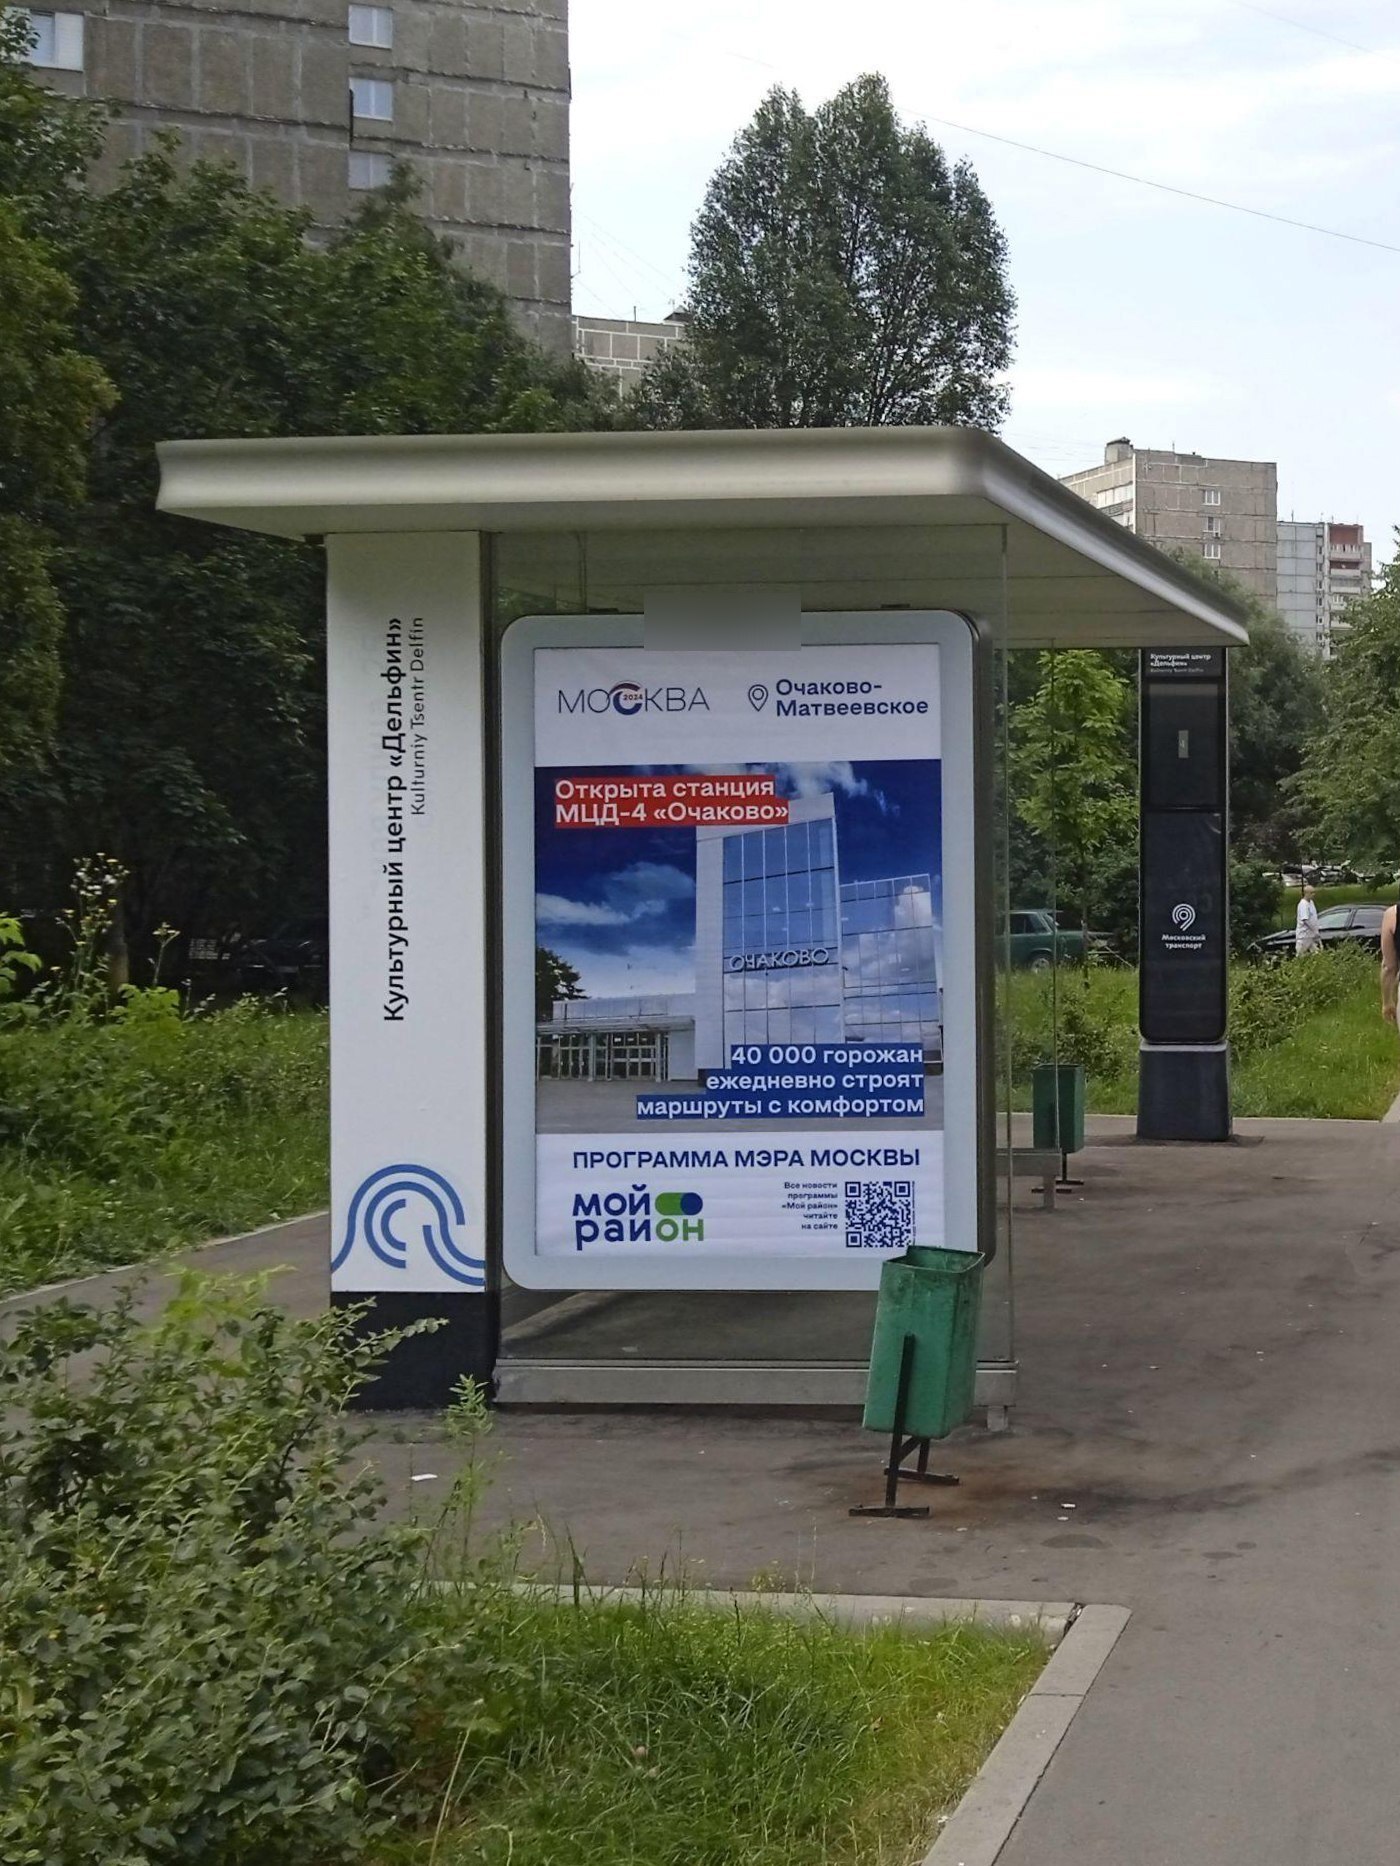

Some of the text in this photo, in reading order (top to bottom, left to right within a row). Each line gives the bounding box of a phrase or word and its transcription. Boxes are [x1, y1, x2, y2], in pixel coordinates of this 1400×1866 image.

[558, 680, 710, 716] МОСКВА
[623, 693, 644, 701] 2024
[776, 679, 883, 698] Очаково-
[409, 616, 428, 816] Kulturniy Tsentr Delfin
[776, 698, 929, 717] Матвеевское
[555, 779, 775, 803] Открыта станция
[380, 616, 409, 1022] Культурный центр «Дельфин»
[556, 802, 789, 826] МЦД-4 «Очаково»
[729, 948, 830, 972] ОЧАКОВО
[731, 1046, 924, 1067] 40 000 горожан
[706, 1073, 924, 1093] ежедневно строят
[637, 1097, 925, 1120] маршруты с комфортом
[573, 1148, 920, 1169] ПРОГРАММА МЭРА МОСКВЫ
[784, 1182, 801, 1190] Все
[787, 1192, 838, 1201] программы
[572, 1183, 651, 1217] мой
[782, 1202, 806, 1210] «Мой
[803, 1212, 838, 1220] читайте
[813, 1222, 838, 1230] сайте
